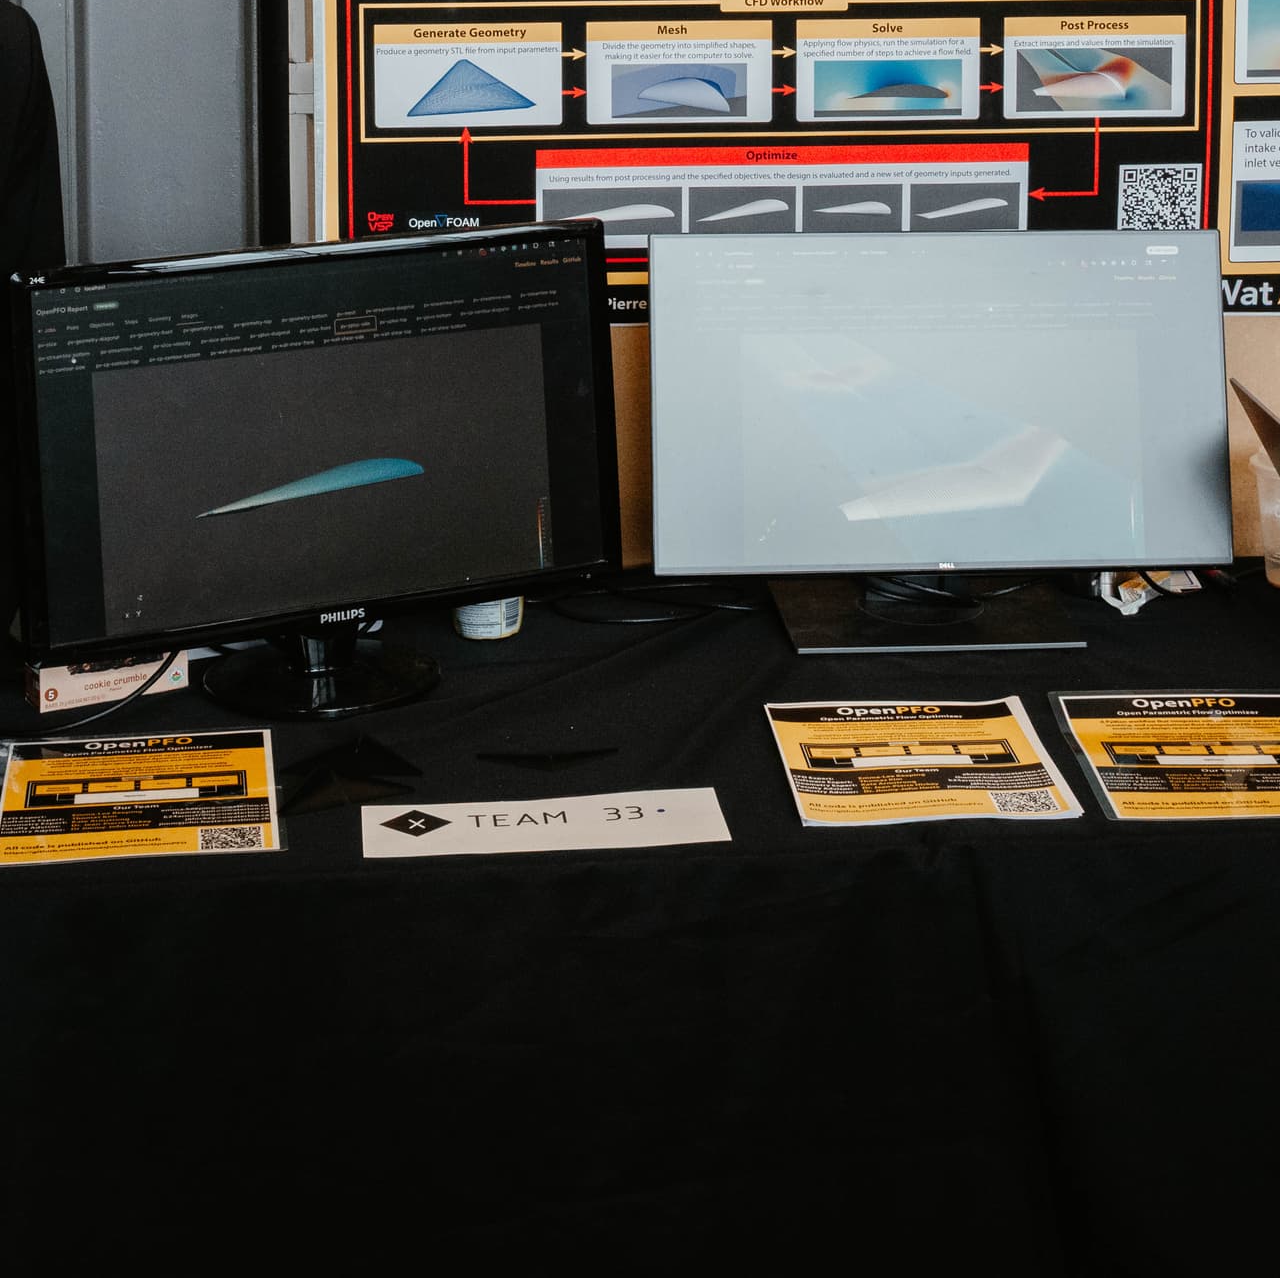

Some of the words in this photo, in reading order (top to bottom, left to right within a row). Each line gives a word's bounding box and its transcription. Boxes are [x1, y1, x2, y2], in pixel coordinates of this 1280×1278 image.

[657, 24, 688, 35] Mesh
[872, 22, 903, 33] Solve
[1060, 20, 1085, 31] Post
[1087, 20, 1129, 30] Process
[412, 28, 467, 39] Generate
[469, 26, 527, 40] Geometry
[746, 150, 798, 163] Optimize
[28, 275, 46, 285] 244E
[35, 306, 66, 317] OpenPFO
[66, 305, 89, 315] Report
[938, 561, 956, 570] DELL
[320, 607, 366, 624] PHILIPS
[83, 679, 111, 692] cookie
[113, 672, 148, 686] crumble
[47, 690, 55, 700] 5
[1131, 698, 1237, 710] OpenPFO
[836, 705, 942, 717] OpenPFO
[84, 736, 194, 751] OpenPFO
[467, 810, 569, 828] TEAM
[602, 805, 645, 822] 33
